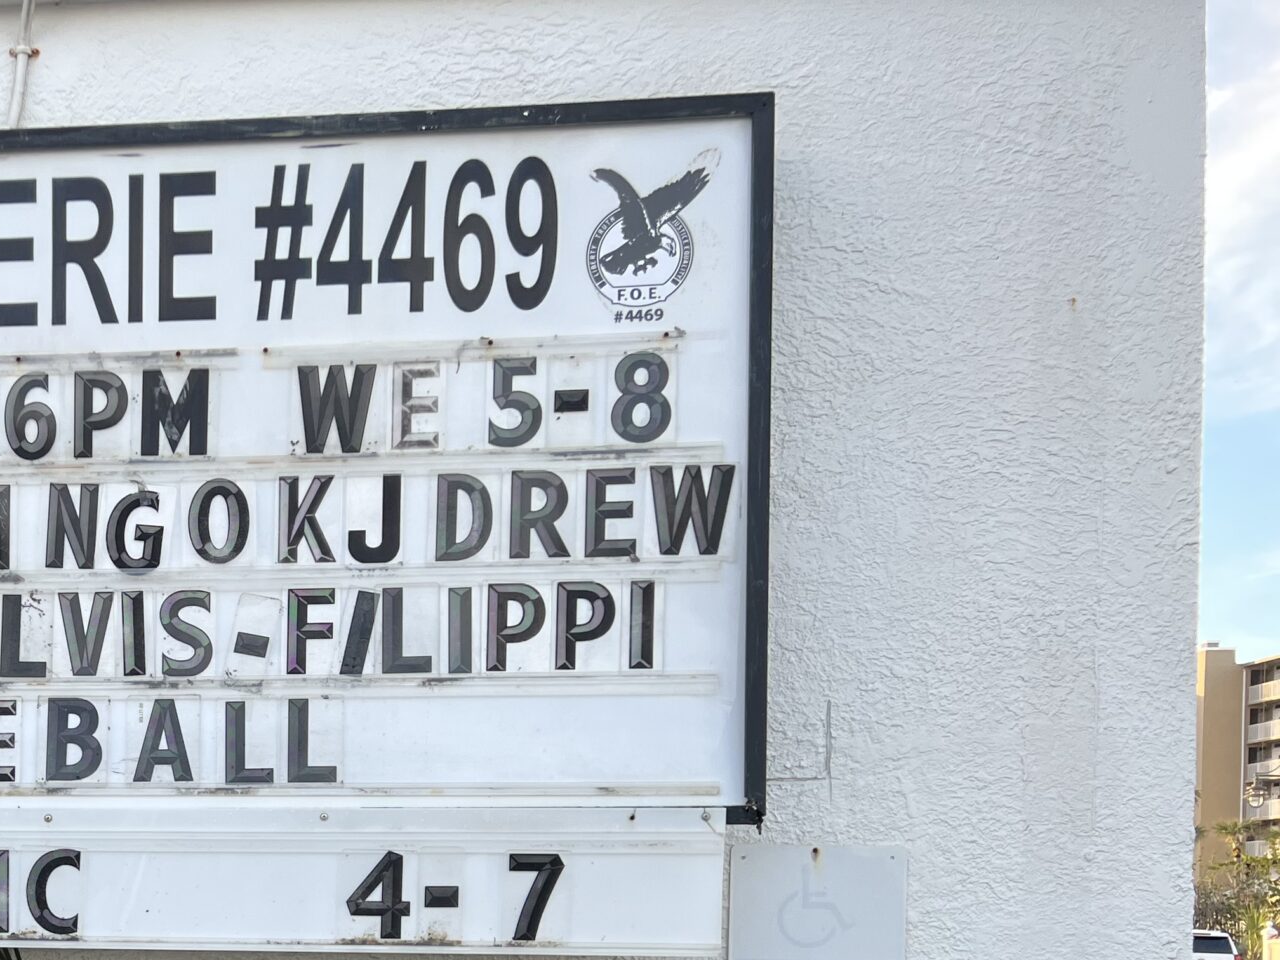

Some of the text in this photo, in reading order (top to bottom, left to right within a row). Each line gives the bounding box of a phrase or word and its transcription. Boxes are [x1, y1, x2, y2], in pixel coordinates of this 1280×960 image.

[253, 156, 558, 321] #4469
[613, 308, 664, 323] #4469
[617, 287, 661, 301] F.O.E.
[4, 368, 210, 461] 6PM
[297, 360, 442, 454] WE
[488, 351, 672, 447] 5-8
[435, 464, 736, 562] DREW
